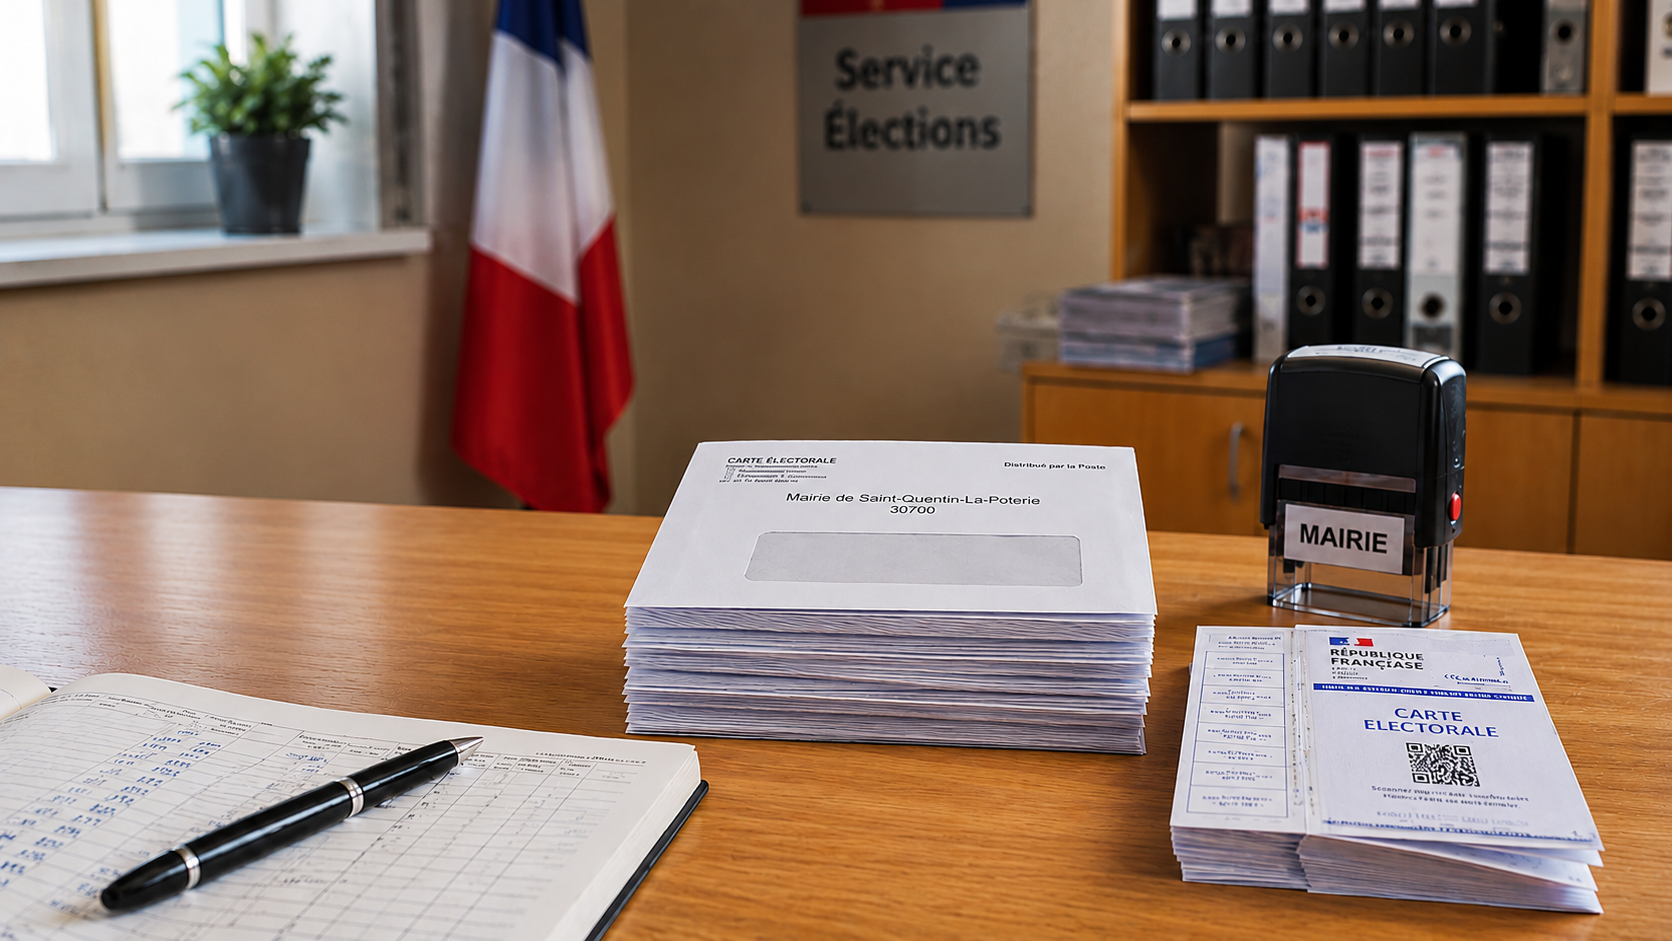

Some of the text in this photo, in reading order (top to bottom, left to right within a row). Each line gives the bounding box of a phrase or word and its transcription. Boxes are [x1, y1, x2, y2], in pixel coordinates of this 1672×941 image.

[834, 45, 981, 91] Service
[824, 99, 1002, 151] Élections
[786, 493, 1041, 505] Mairie de Saint-Quentin-La-Poterie
[890, 505, 936, 514] 30700
[1300, 523, 1389, 554] MAIRIE
[1394, 708, 1463, 722] CARTE
[1364, 719, 1499, 738] ELECTORALE
